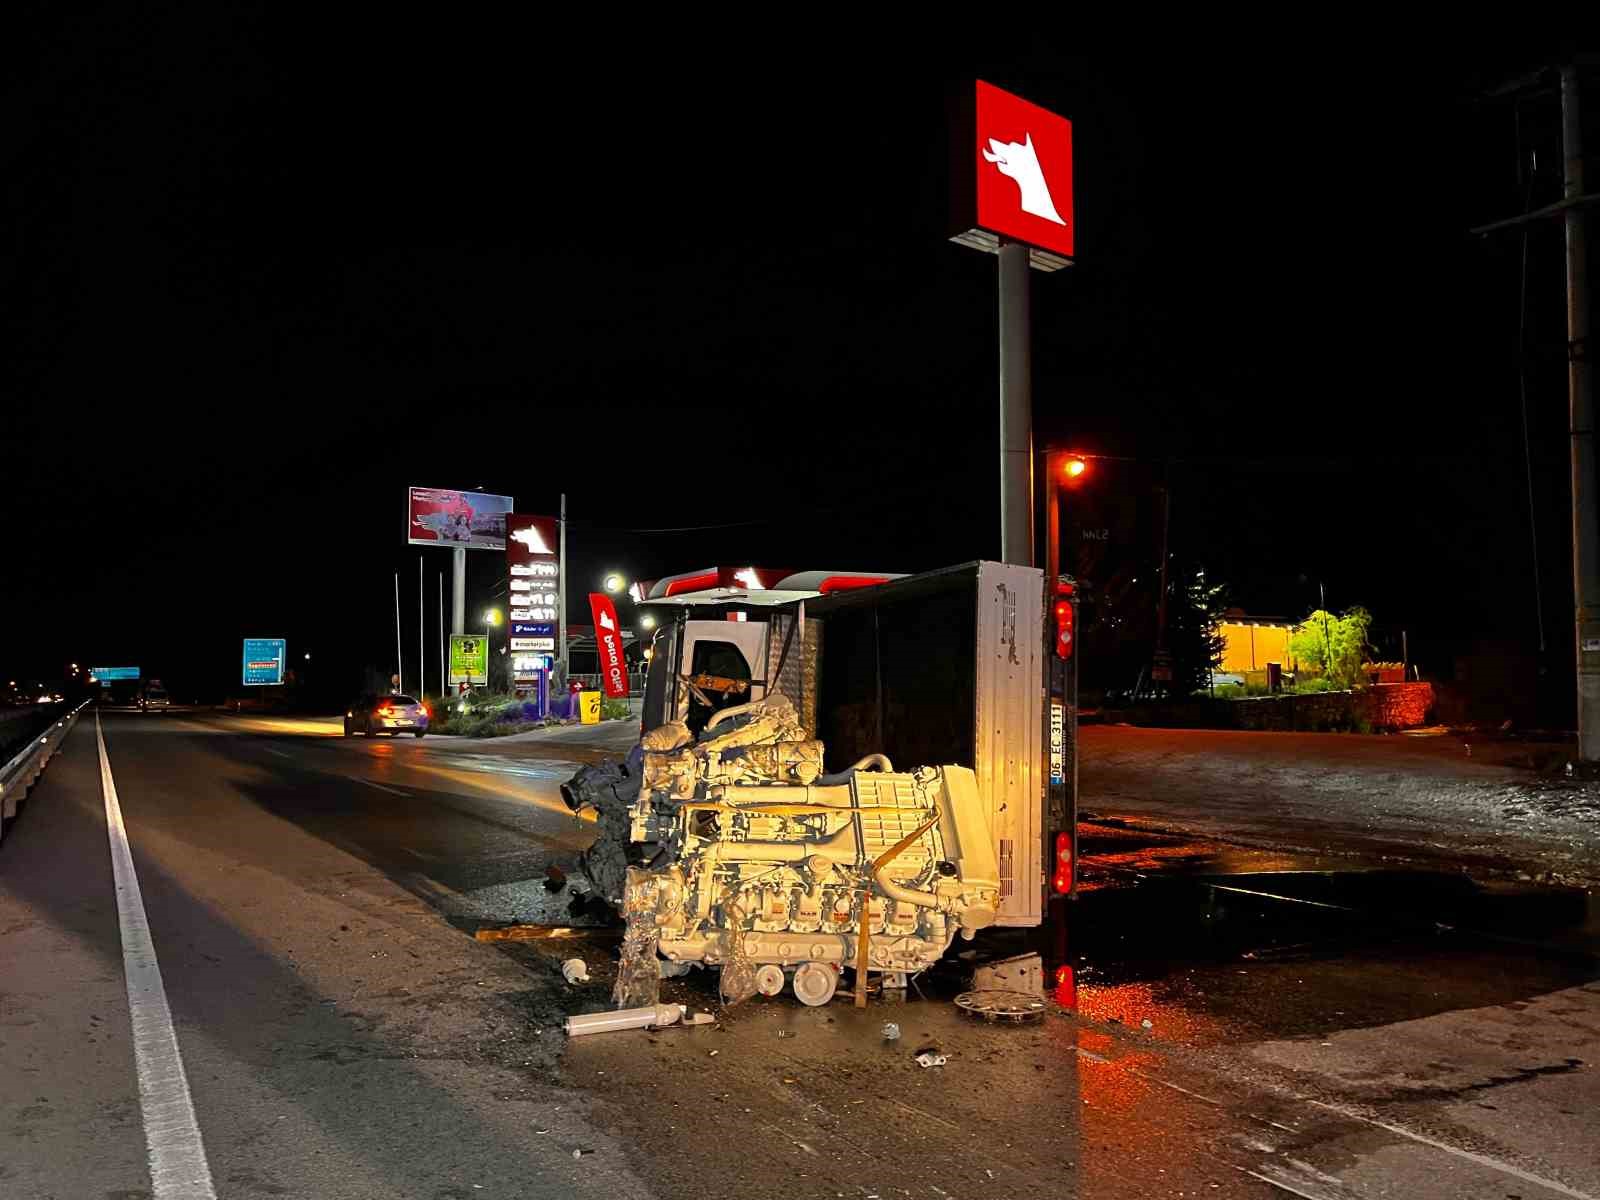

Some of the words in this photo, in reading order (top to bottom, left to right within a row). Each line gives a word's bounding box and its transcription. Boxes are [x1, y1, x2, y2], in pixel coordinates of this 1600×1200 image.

[1051, 706, 1061, 734] 3111
[1051, 740, 1061, 755] EC
[1051, 763, 1061, 777] 06
